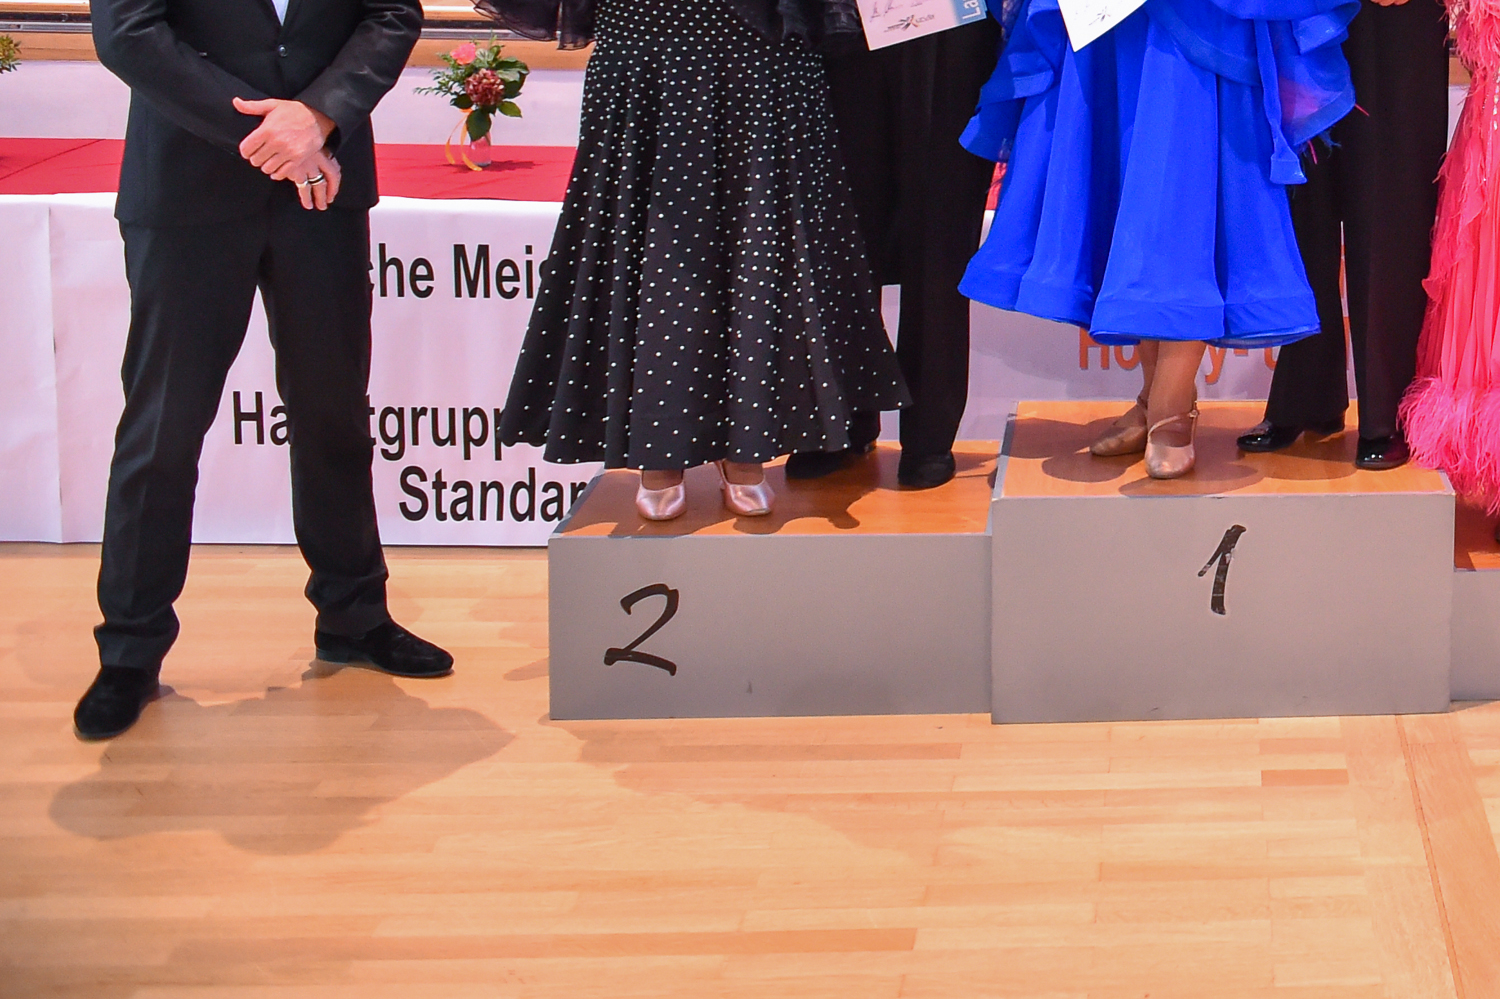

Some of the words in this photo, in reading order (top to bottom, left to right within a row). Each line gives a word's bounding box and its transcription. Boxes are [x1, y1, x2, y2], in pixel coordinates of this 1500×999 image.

[399, 465, 588, 523] Standar
[1196, 522, 1247, 616] 1
[603, 581, 680, 676] 2
